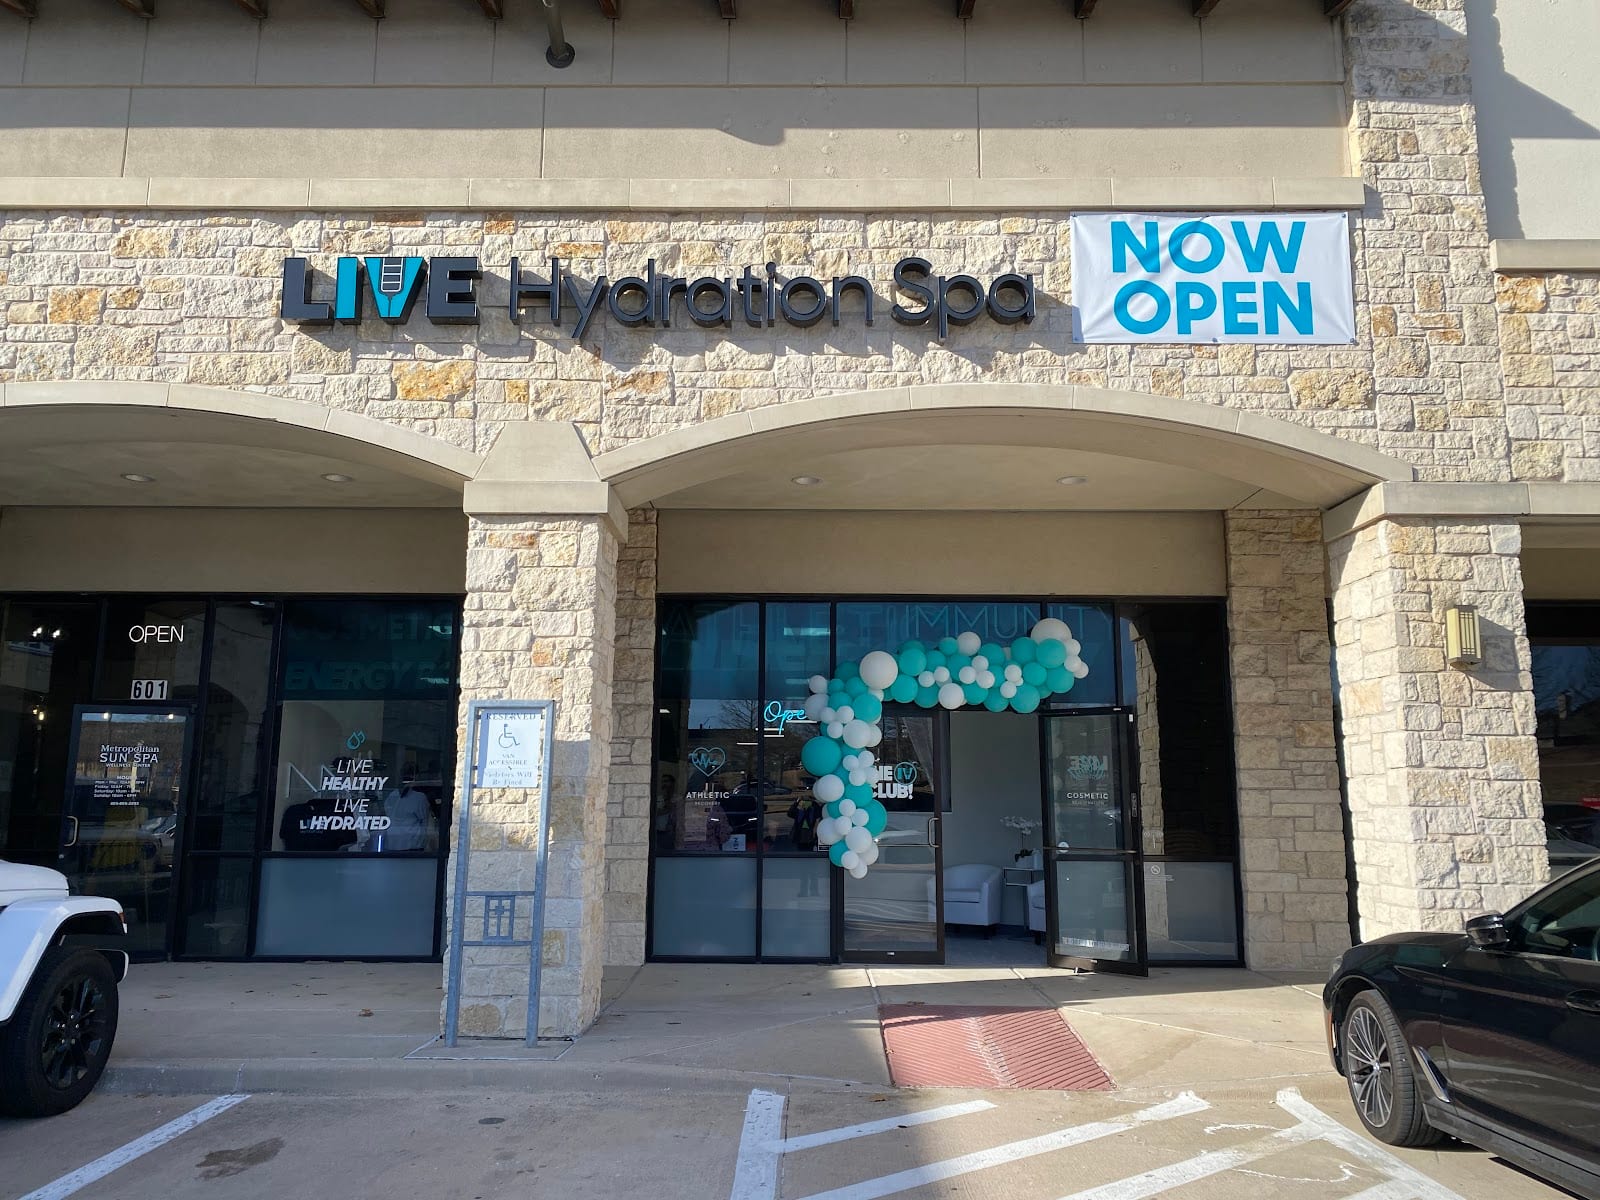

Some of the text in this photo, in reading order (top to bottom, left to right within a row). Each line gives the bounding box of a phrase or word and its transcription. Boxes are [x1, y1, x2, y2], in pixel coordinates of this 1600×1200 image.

[1110, 220, 1306, 274] NOW
[281, 256, 1036, 340] LIVE Hydration Spa
[1113, 280, 1314, 335] OPEN
[128, 624, 184, 643] OPEN
[133, 680, 165, 699] 601
[486, 712, 537, 720] RESERVED
[764, 701, 808, 736] Ope
[101, 744, 160, 755] Metropolitan
[100, 752, 159, 764] SUN SPA
[336, 759, 374, 774] LIVE
[321, 776, 389, 791] HEALTHY
[686, 791, 730, 799] ATHLETIC
[333, 798, 370, 813] LIVE
[310, 815, 391, 830] HYDRATED
